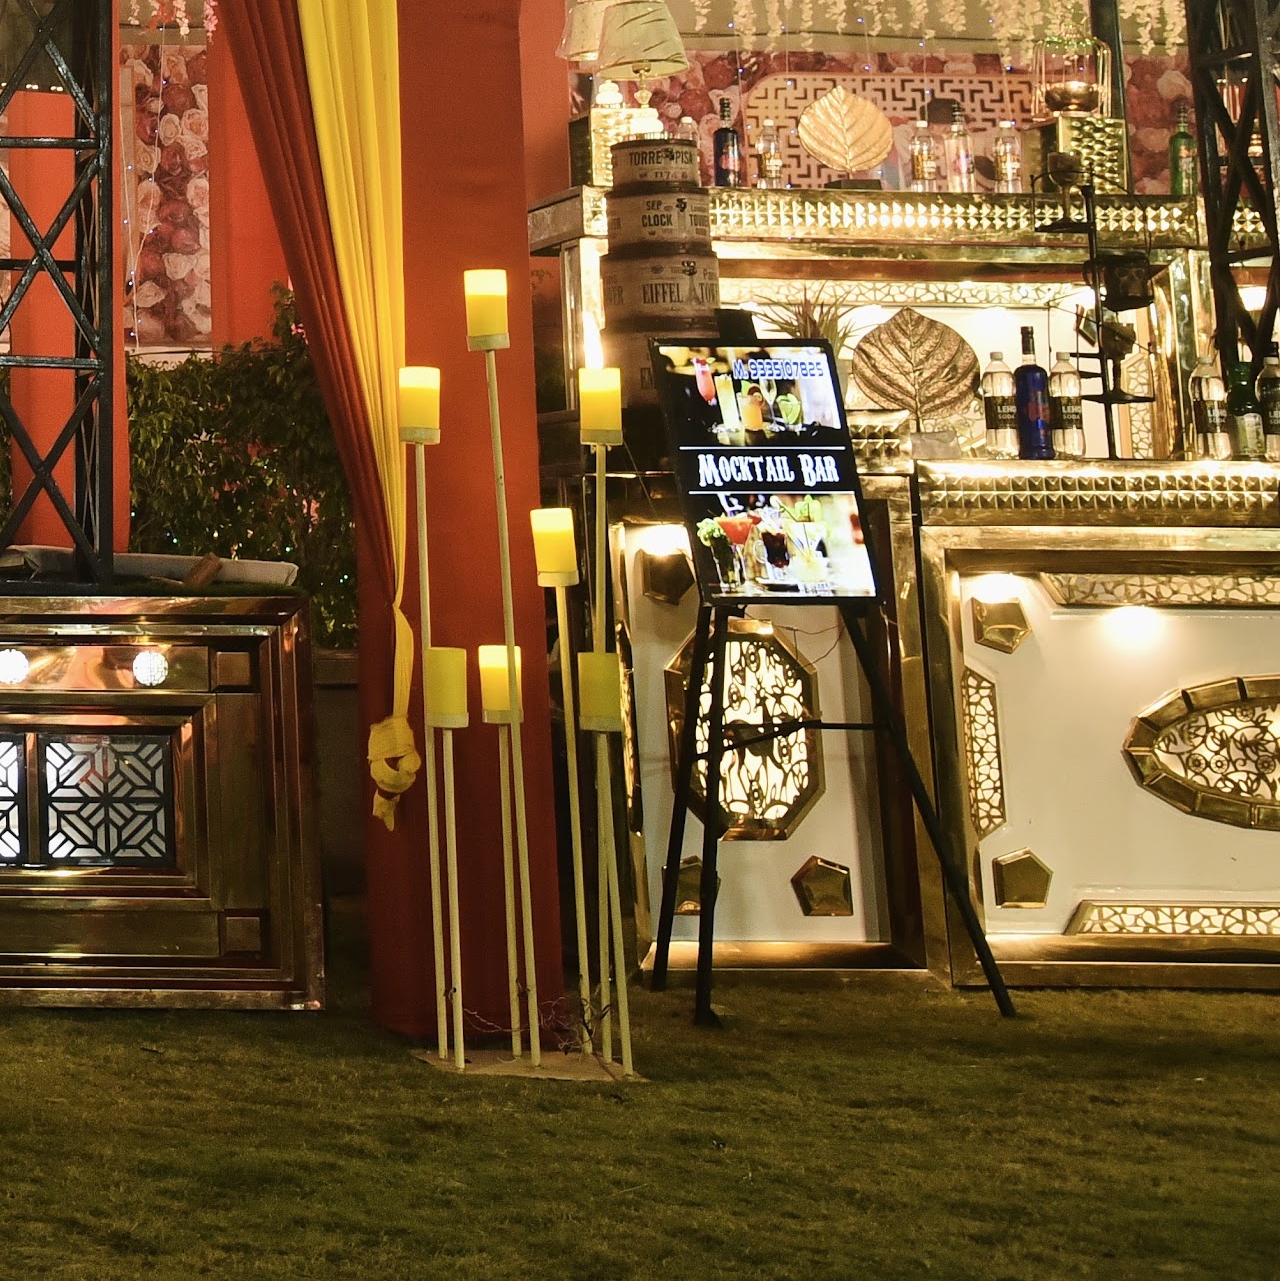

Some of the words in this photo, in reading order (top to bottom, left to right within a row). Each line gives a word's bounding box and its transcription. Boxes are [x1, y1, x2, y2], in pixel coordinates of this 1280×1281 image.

[629, 150, 662, 167] TORRE
[641, 214, 673, 227] CLOCK
[642, 282, 684, 305] EIFFEL
[733, 360, 748, 379] M.
[748, 359, 824, 379] 9335107825
